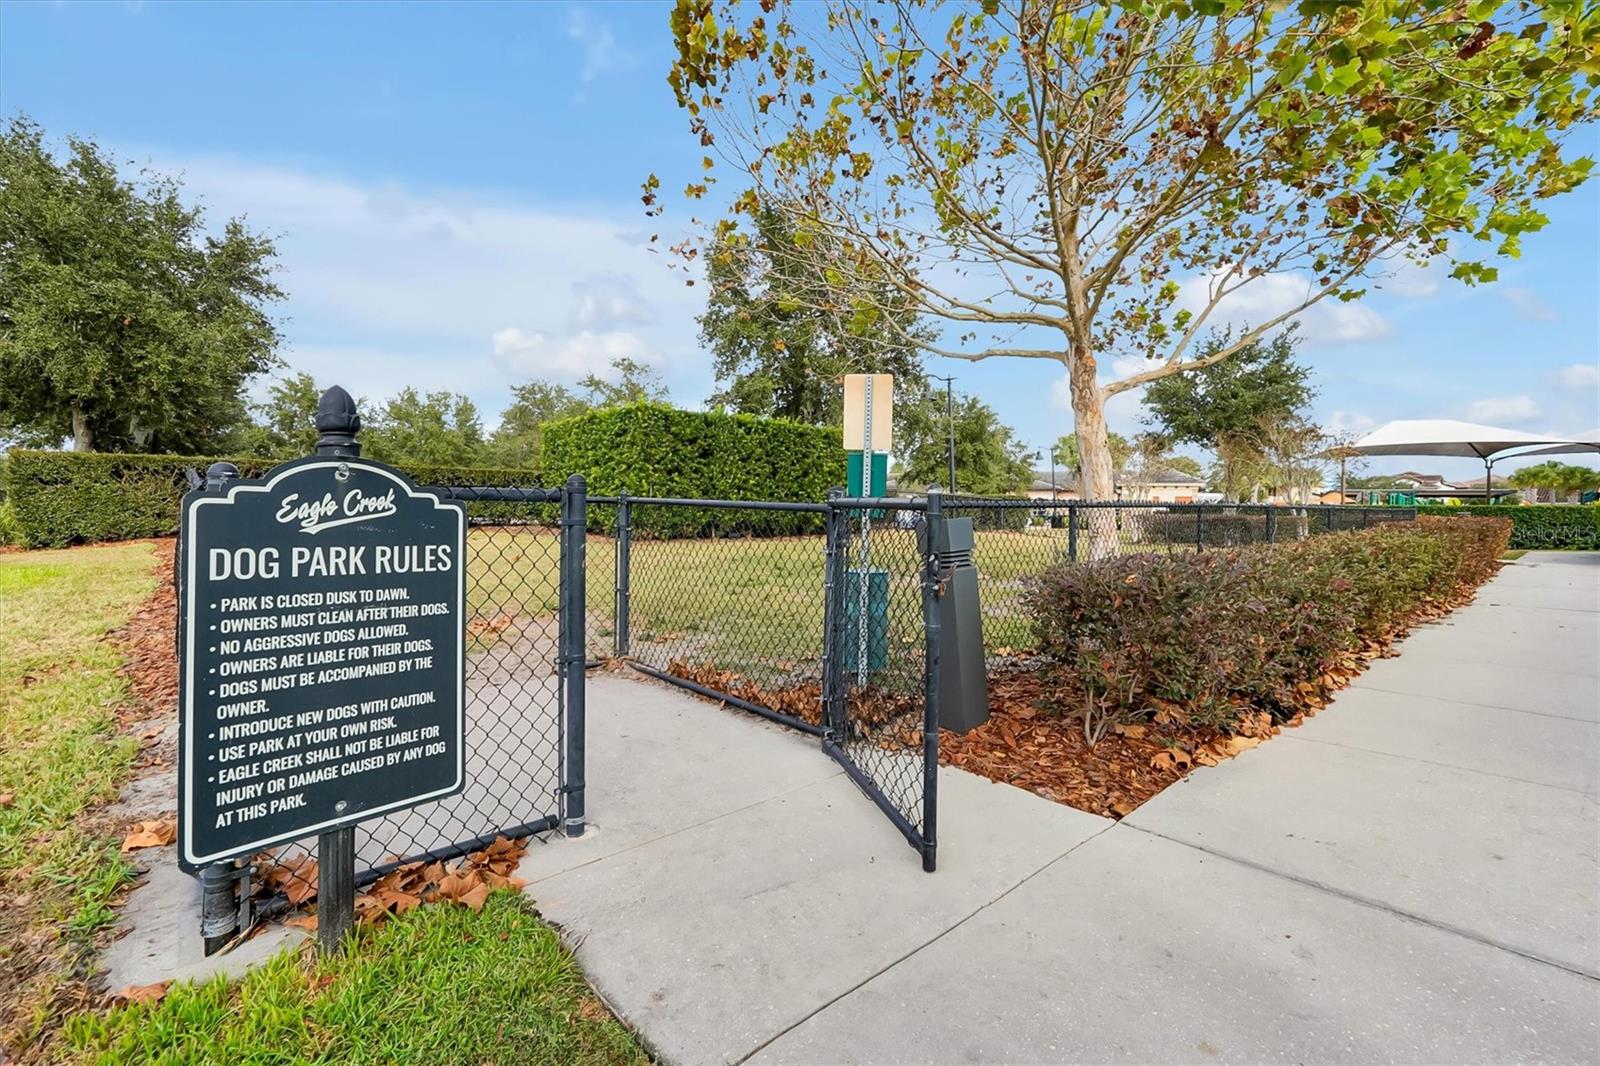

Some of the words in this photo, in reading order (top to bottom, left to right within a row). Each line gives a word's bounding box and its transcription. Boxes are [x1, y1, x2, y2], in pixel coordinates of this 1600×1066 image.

[276, 493, 338, 527] Eagle
[343, 488, 397, 516] Creek
[209, 547, 279, 581] DOG
[292, 546, 366, 577] PARK
[375, 544, 451, 574] RULES
[220, 616, 278, 634] OWNERS
[281, 612, 316, 628] MUST
[318, 609, 353, 625] CLEAN
[356, 606, 389, 622] AFTER
[389, 605, 419, 619] THEIR
[421, 602, 450, 616] DOGS.
[221, 596, 258, 612] PARK
[261, 595, 274, 610] IS
[276, 593, 323, 609] CLOSED
[327, 590, 357, 605] DUSK
[359, 589, 374, 603] TO
[376, 588, 410, 602] DAWN.
[220, 640, 240, 655] NO
[243, 632, 321, 653] AGGRESSIVE
[323, 628, 355, 644] DOGS
[357, 624, 409, 641] ALLOWED.
[220, 657, 277, 676] OWNERS
[280, 653, 304, 669] ARE
[307, 648, 346, 666] LIABLE
[348, 646, 369, 660] FOR
[371, 642, 402, 657] THEIR
[404, 639, 434, 654] DOGS.
[220, 679, 258, 698] DOGS
[261, 674, 297, 692] MUST
[299, 671, 315, 686] BE
[317, 661, 396, 684] ACCOMPANIED
[398, 659, 413, 672] BY
[414, 656, 433, 670] THE
[217, 699, 270, 720] OWNER.
[219, 715, 294, 741] INTRODUCE
[296, 709, 324, 727] NEW
[326, 704, 358, 722] DOGS
[360, 699, 388, 715] WITH
[390, 691, 436, 710] CAUTION.
[218, 762, 260, 784] EAGLE
[263, 753, 303, 774] CREEK
[305, 746, 343, 765] SHALL
[345, 740, 367, 756] NOT
[369, 736, 383, 751] BE
[385, 729, 419, 748] LIABLE
[421, 725, 440, 740] FOR
[219, 744, 246, 762] USE
[249, 737, 284, 756] PARK
[286, 733, 303, 749] AT
[304, 727, 338, 745] YOUR
[340, 721, 367, 738] OWN
[370, 716, 397, 732] RISK.
[216, 782, 264, 807] INJURY
[267, 778, 285, 793] OR
[289, 765, 339, 789] DAMAGE
[341, 755, 384, 776] CAUSED
[387, 751, 401, 766] BY
[403, 746, 424, 762] ANY
[425, 741, 446, 757] DOG
[215, 810, 234, 829] AT
[236, 803, 267, 823] THIS
[270, 793, 307, 814] PARK.
